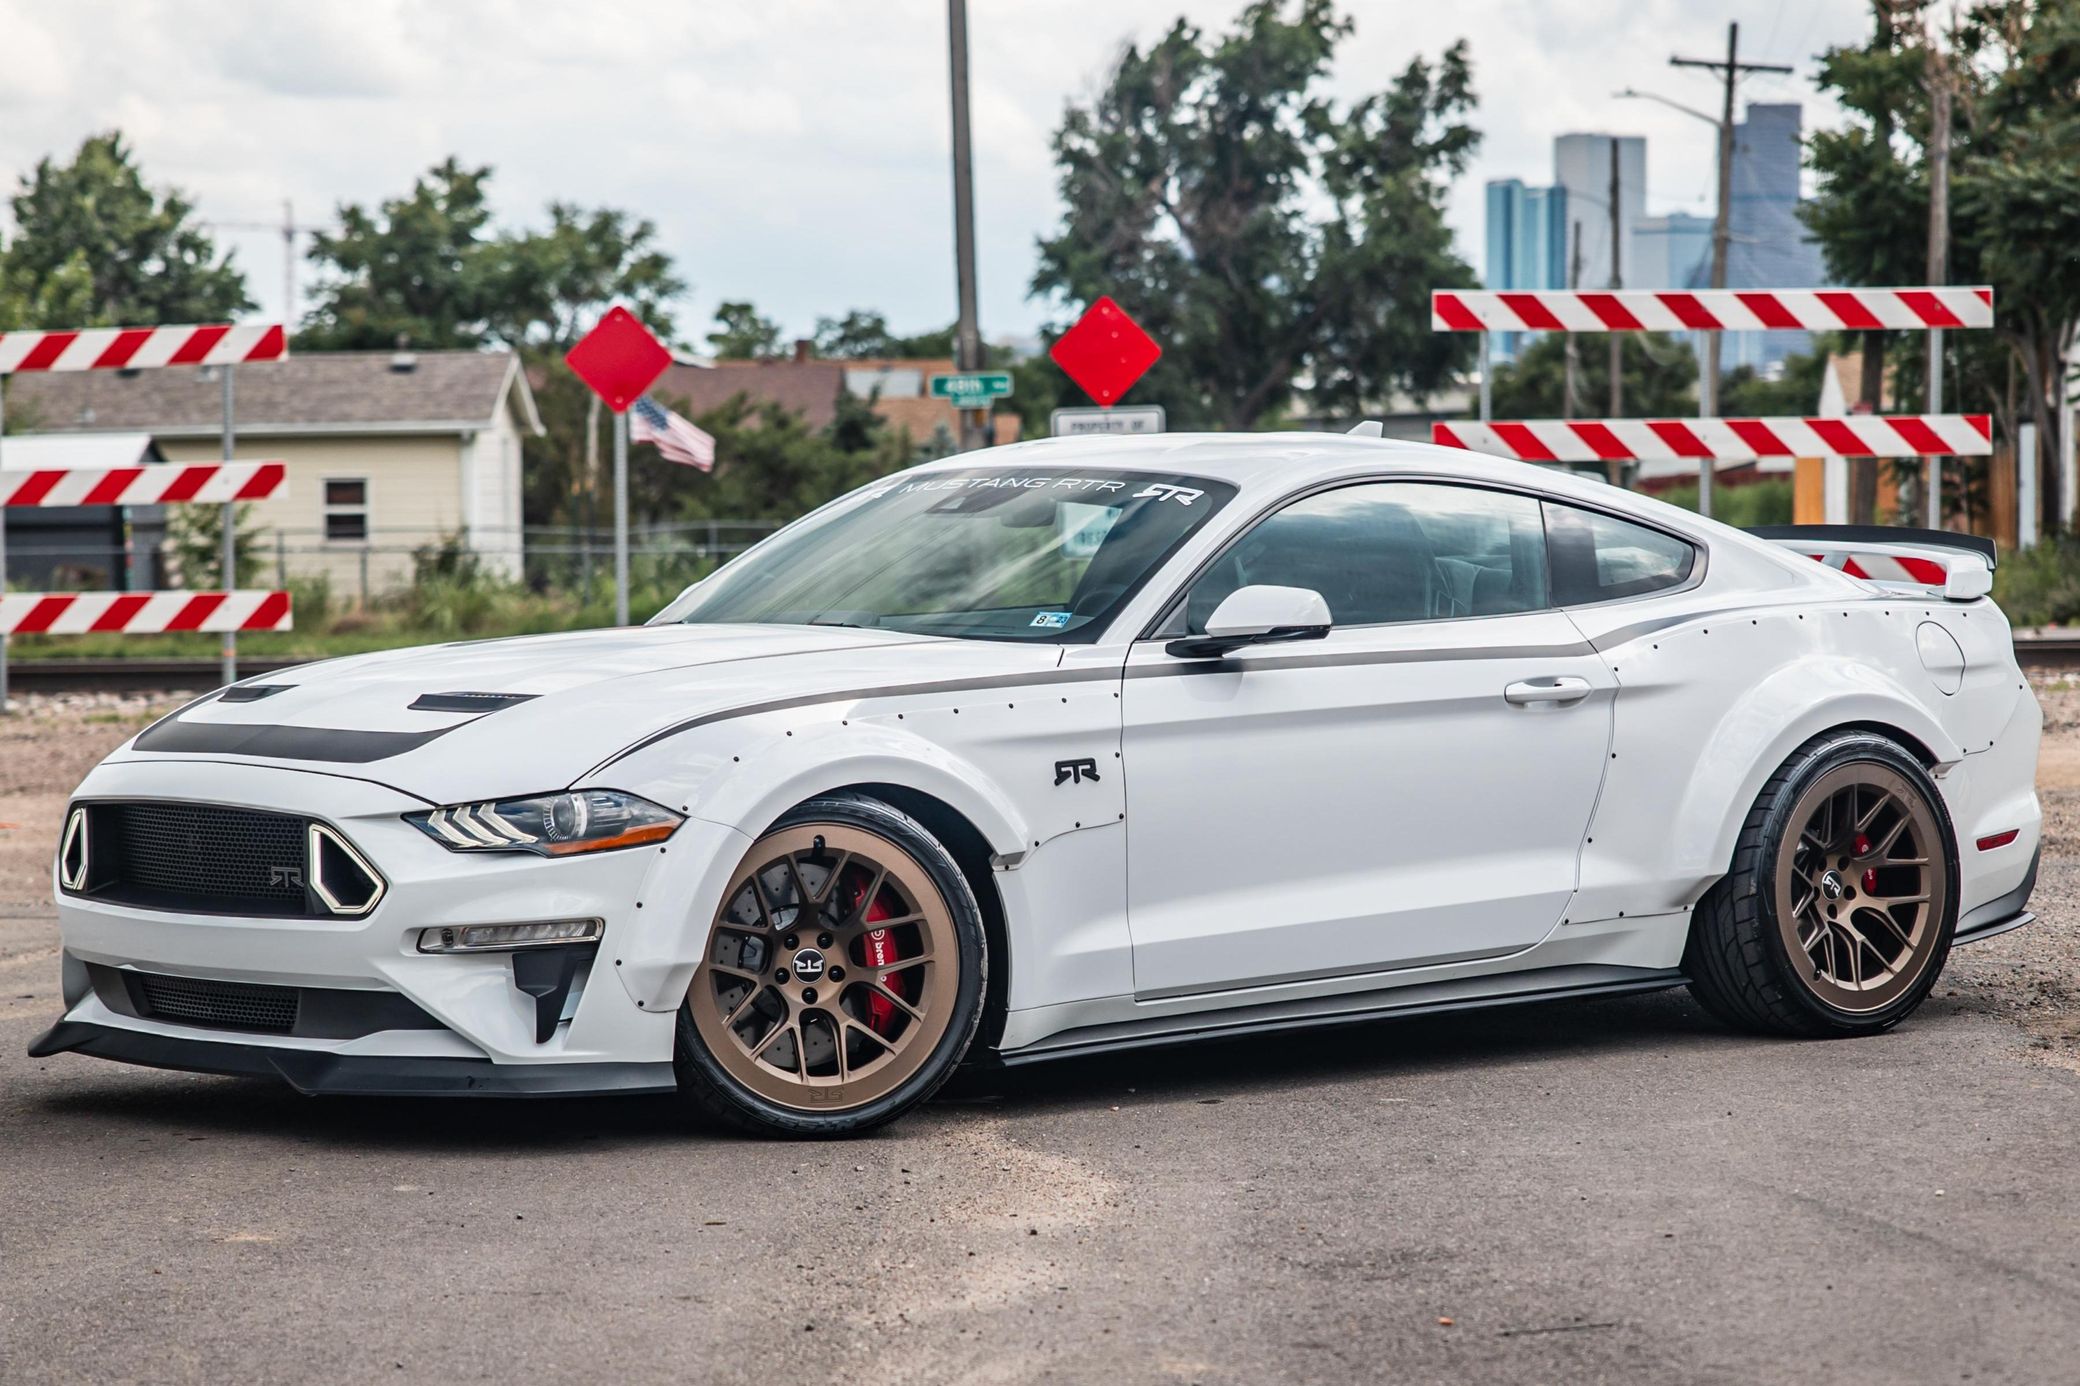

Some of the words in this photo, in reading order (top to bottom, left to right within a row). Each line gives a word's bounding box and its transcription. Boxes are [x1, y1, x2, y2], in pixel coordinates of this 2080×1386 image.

[899, 478, 1051, 494] MUSTANG
[1052, 478, 1126, 493] RTR
[1132, 483, 1205, 506] RTR
[1036, 615, 1047, 625] 8
[1054, 757, 1101, 787] RTR
[270, 866, 305, 888] RTR
